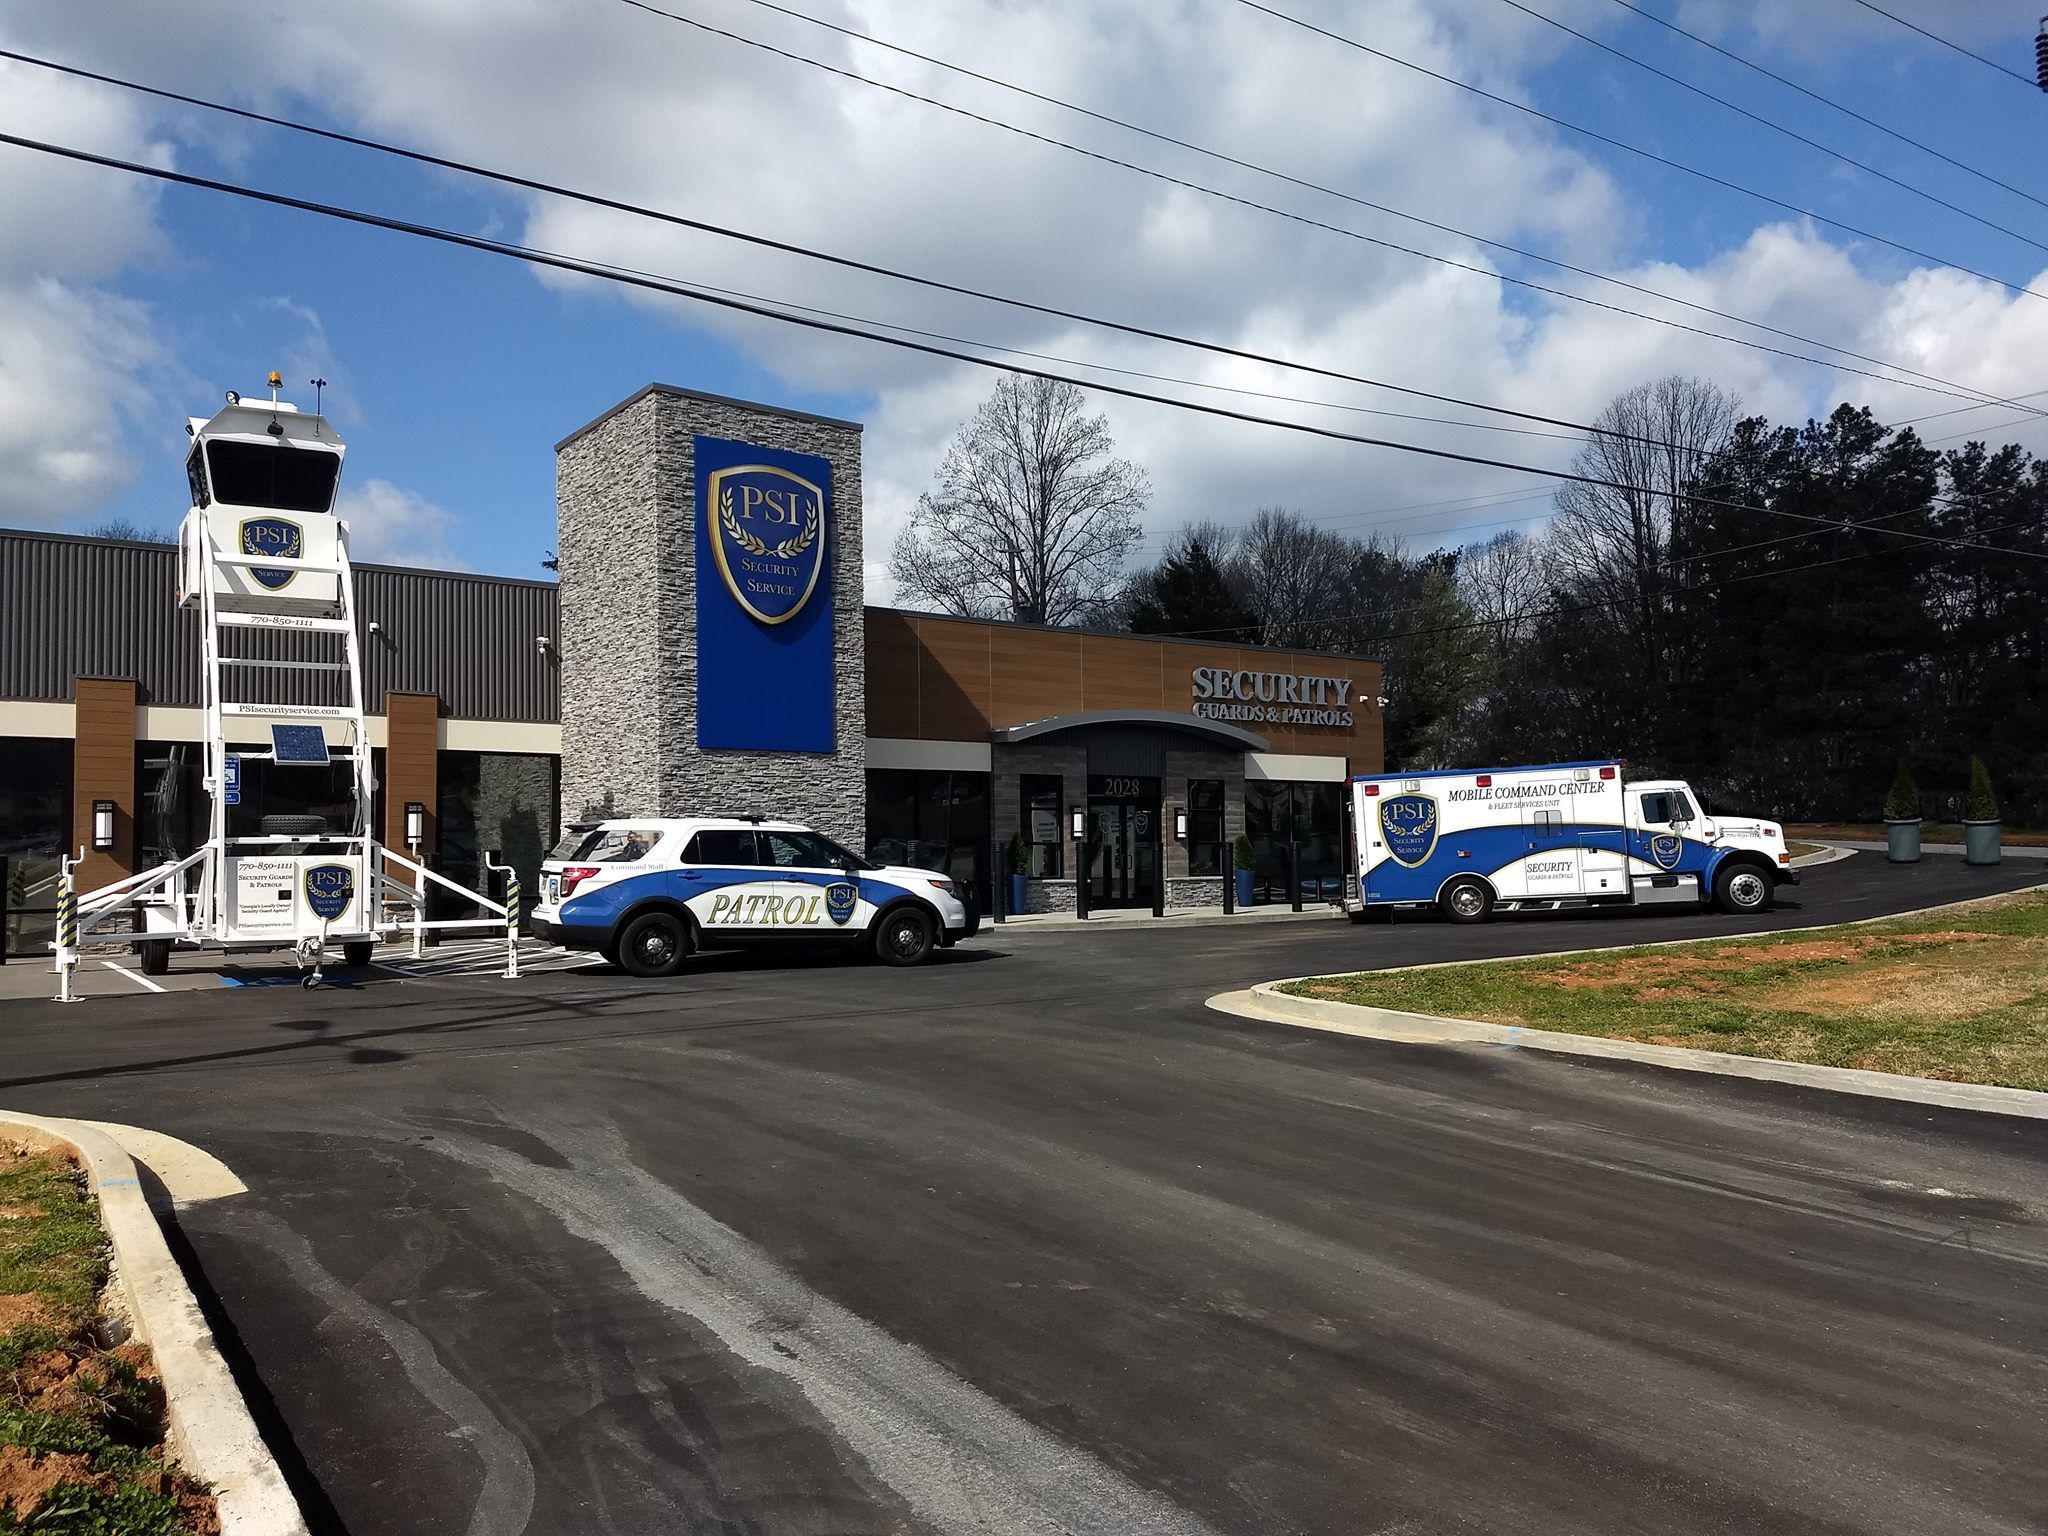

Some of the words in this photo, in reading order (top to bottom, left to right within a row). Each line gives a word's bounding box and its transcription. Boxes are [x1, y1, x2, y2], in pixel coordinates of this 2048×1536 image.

[739, 485, 800, 526] PSI
[254, 525, 289, 545] PSI
[741, 557, 800, 577] SECURITY
[747, 578, 796, 596] SERVICE
[250, 615, 313, 627] 770-850-1111
[1192, 666, 1353, 707] SECURITY
[239, 704, 340, 716] PSIsecurityservice.com
[1192, 702, 1265, 722] GUARDS
[1265, 706, 1280, 723] &
[1281, 707, 1354, 727] PATROLS
[1104, 778, 1140, 796] 2028
[1448, 788, 1493, 802] MOBILE
[1494, 784, 1556, 799] COMMAND
[1559, 781, 1605, 796] CENTER
[1391, 802, 1425, 820] PSI
[1494, 802, 1513, 810] FLEET
[1514, 800, 1544, 809] SERVICES
[1545, 799, 1560, 807] UNIT
[1660, 839, 1675, 847] PSI
[239, 862, 293, 871] 770-850-1111
[1527, 861, 1573, 873] SECURITY
[316, 871, 344, 885] PSI
[833, 889, 851, 898] PSI
[706, 894, 821, 925] PATROL
